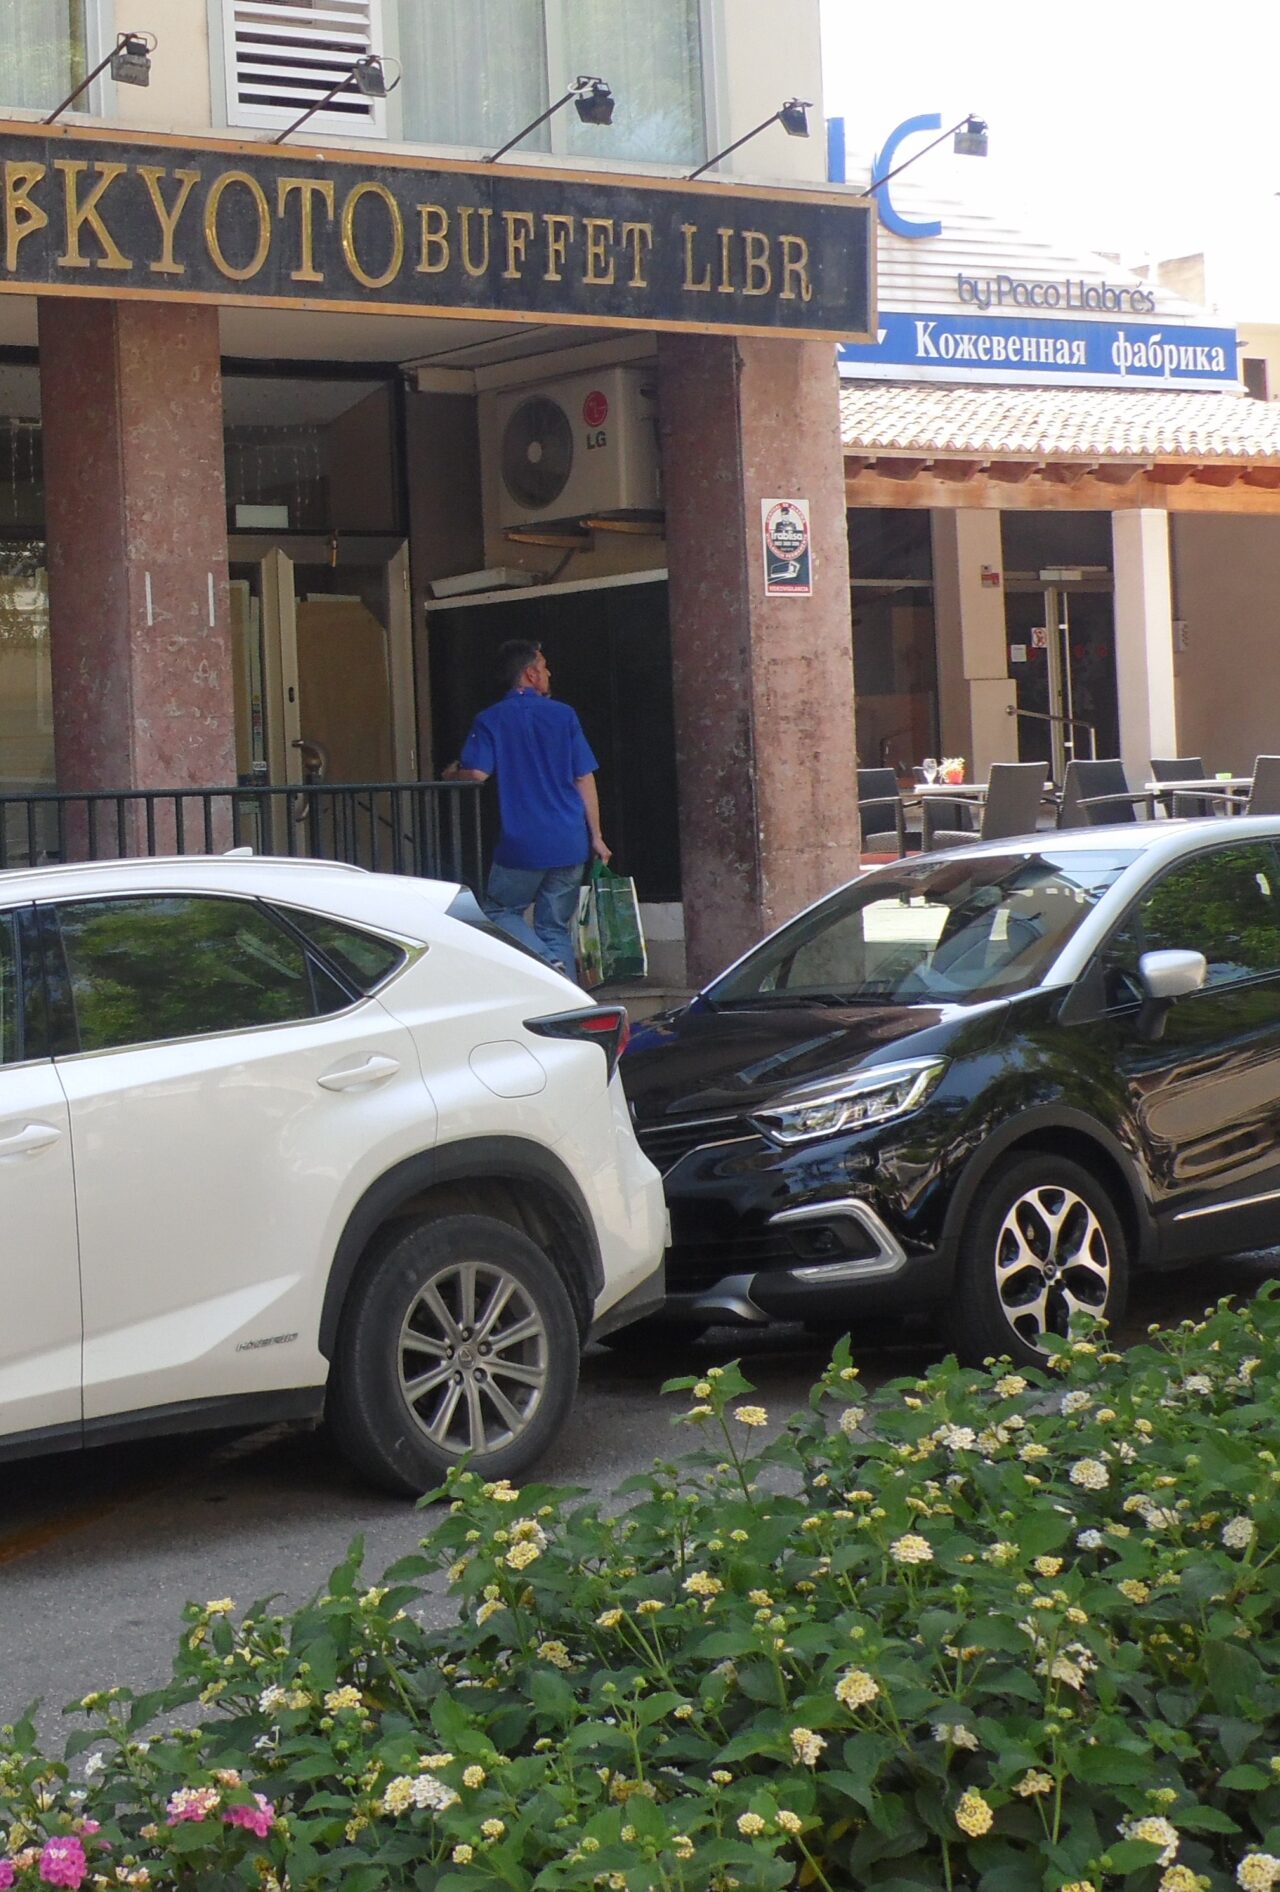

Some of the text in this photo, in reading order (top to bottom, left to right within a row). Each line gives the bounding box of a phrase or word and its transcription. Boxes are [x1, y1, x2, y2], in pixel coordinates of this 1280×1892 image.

[56, 159, 405, 288] KYOTO
[415, 203, 815, 302] BUFFET LIBR
[957, 273, 1155, 312] by Paco Llabrés
[915, 322, 1086, 365] Кожевенная
[1111, 332, 1226, 380] фабрика
[586, 431, 607, 449] LG
